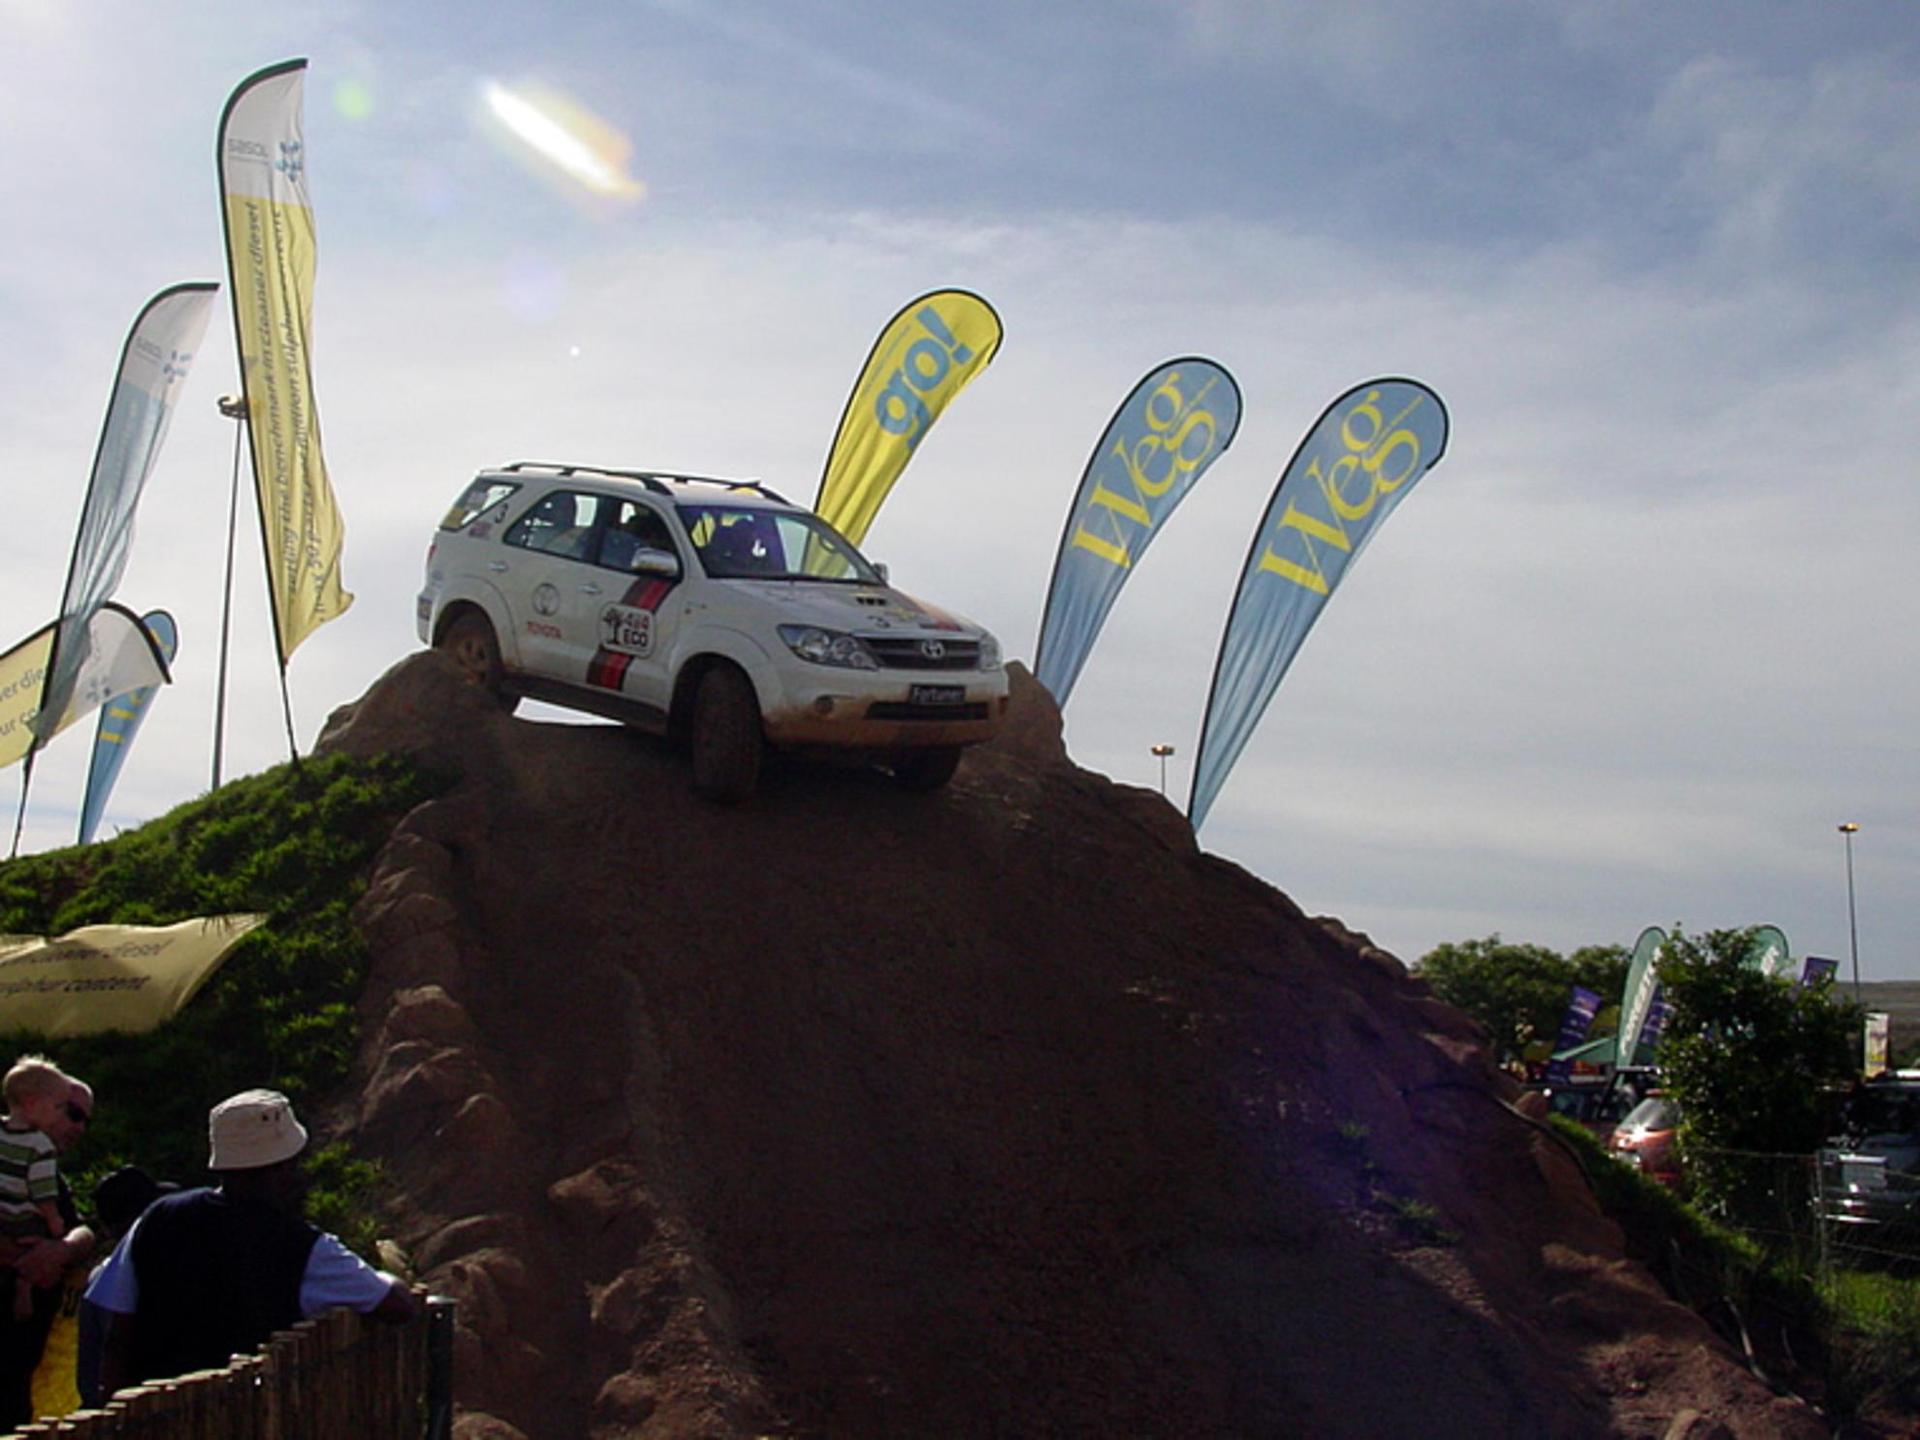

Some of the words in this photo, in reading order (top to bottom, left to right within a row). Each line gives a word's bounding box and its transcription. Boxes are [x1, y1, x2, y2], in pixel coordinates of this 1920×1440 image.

[245, 202, 263, 264] diesel
[256, 269, 271, 347] cleaner
[261, 350, 272, 369] in
[874, 305, 973, 449] go!
[266, 375, 288, 486] benchmark
[1072, 372, 1216, 569] Weg
[1257, 390, 1422, 597] Weg
[278, 489, 291, 523] the
[527, 620, 562, 640] TOYOTA
[623, 629, 649, 648] ECO
